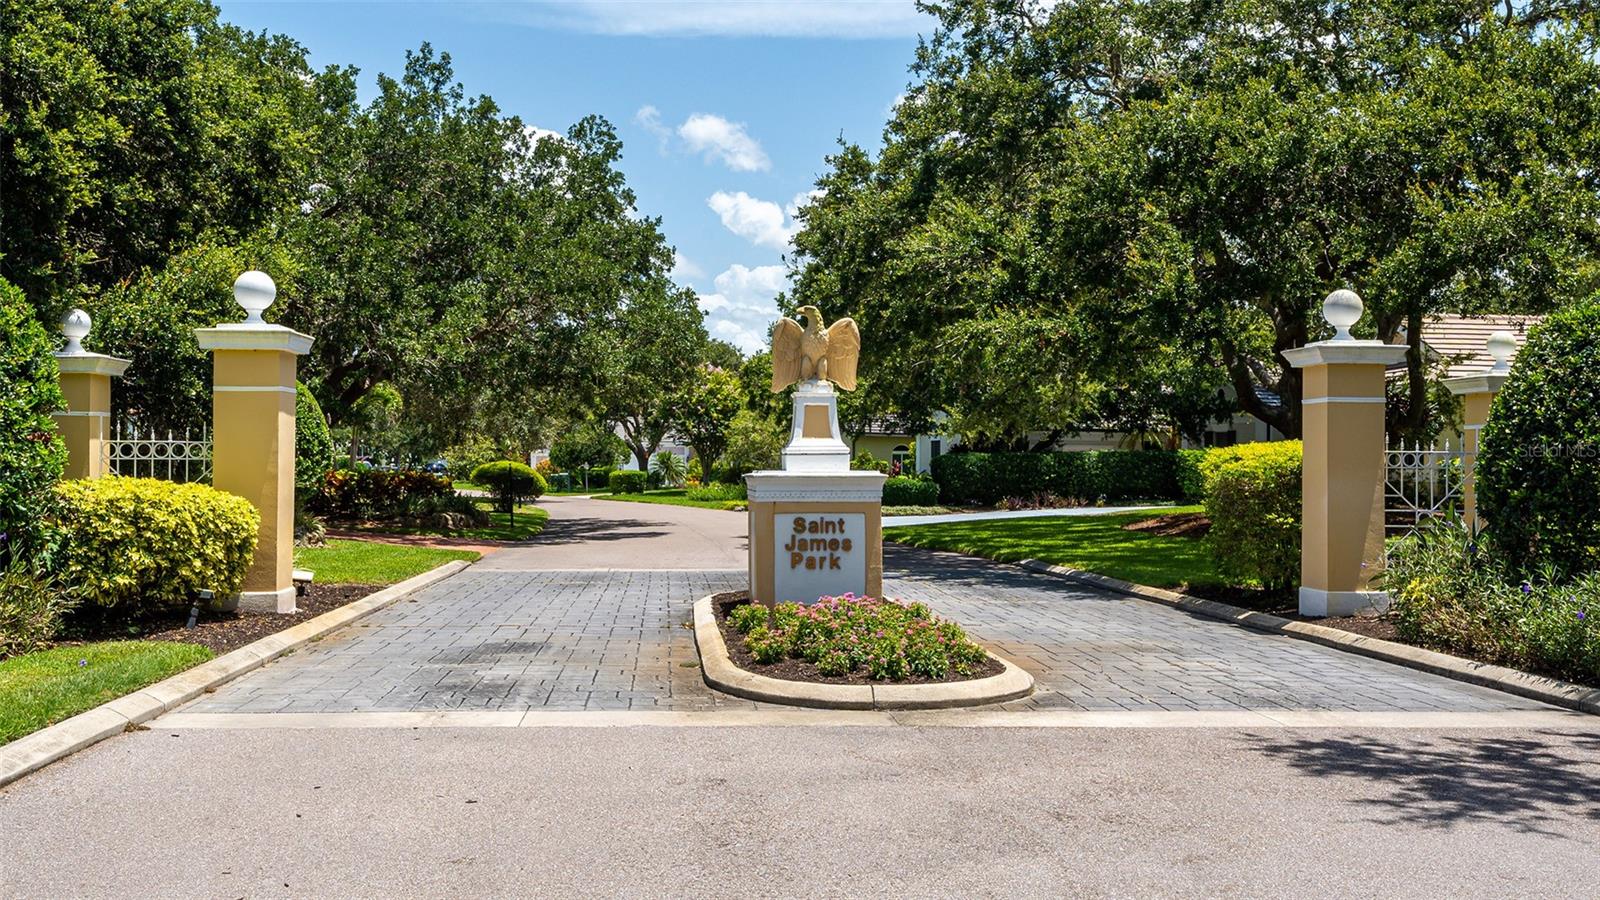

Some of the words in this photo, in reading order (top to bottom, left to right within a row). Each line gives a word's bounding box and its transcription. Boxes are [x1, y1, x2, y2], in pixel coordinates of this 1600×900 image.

[793, 517, 845, 534] Saint
[785, 534, 853, 552] James
[791, 552, 841, 570] Park
